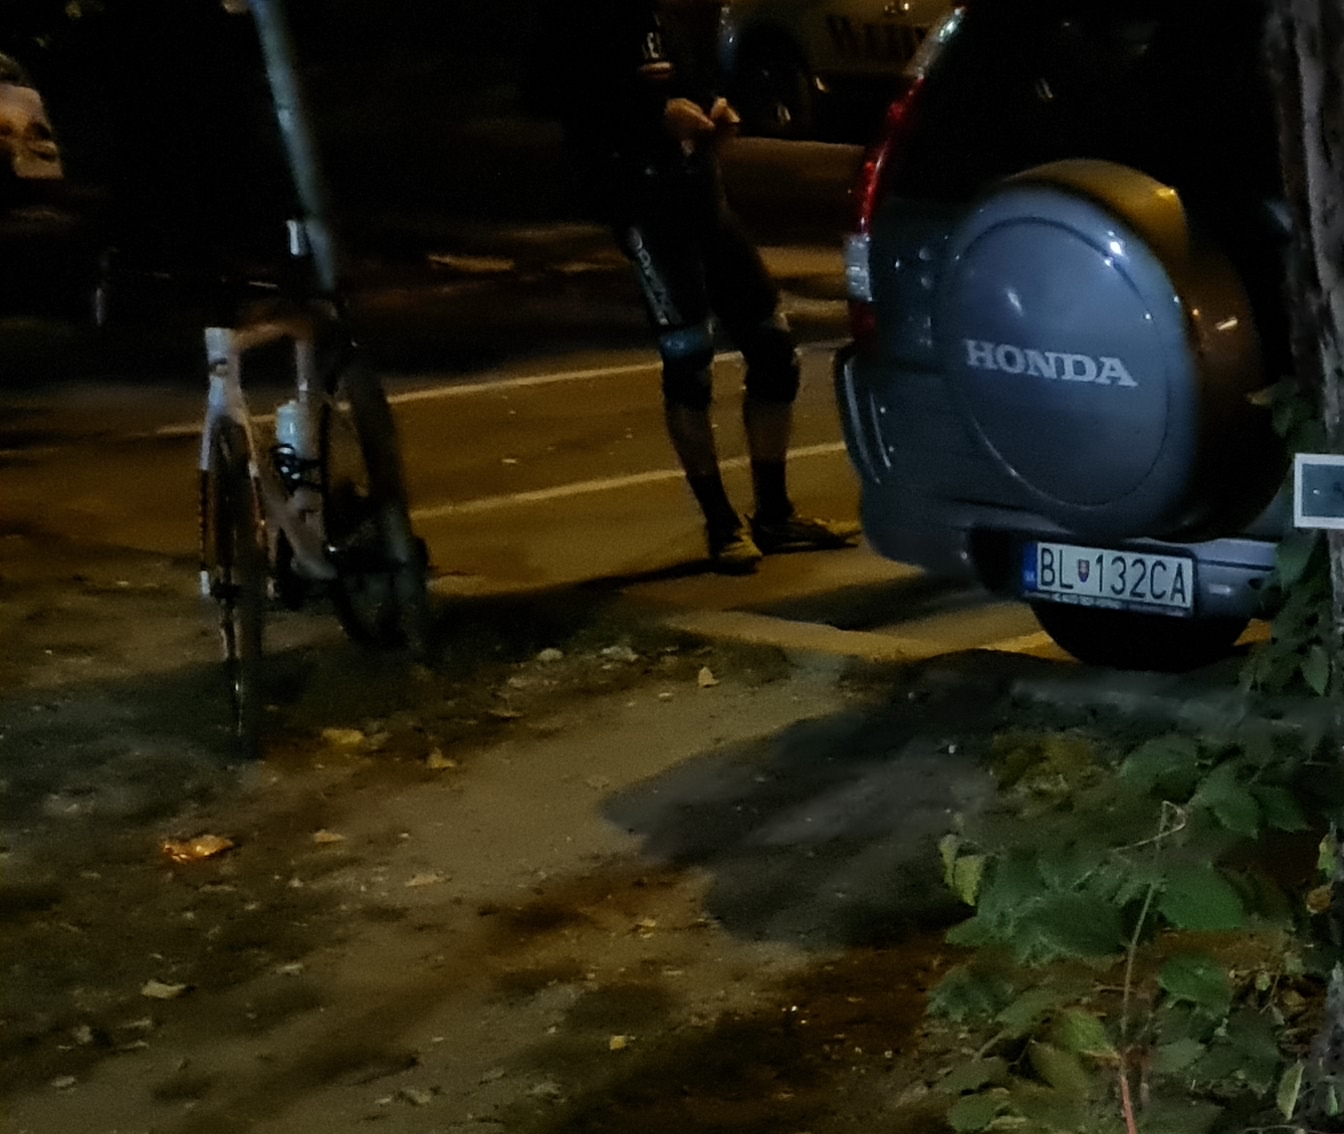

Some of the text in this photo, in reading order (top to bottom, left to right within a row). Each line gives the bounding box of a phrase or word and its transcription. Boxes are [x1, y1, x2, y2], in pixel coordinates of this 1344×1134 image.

[964, 339, 1138, 387] HONDA
[1040, 547, 1187, 604] BL 132CA
